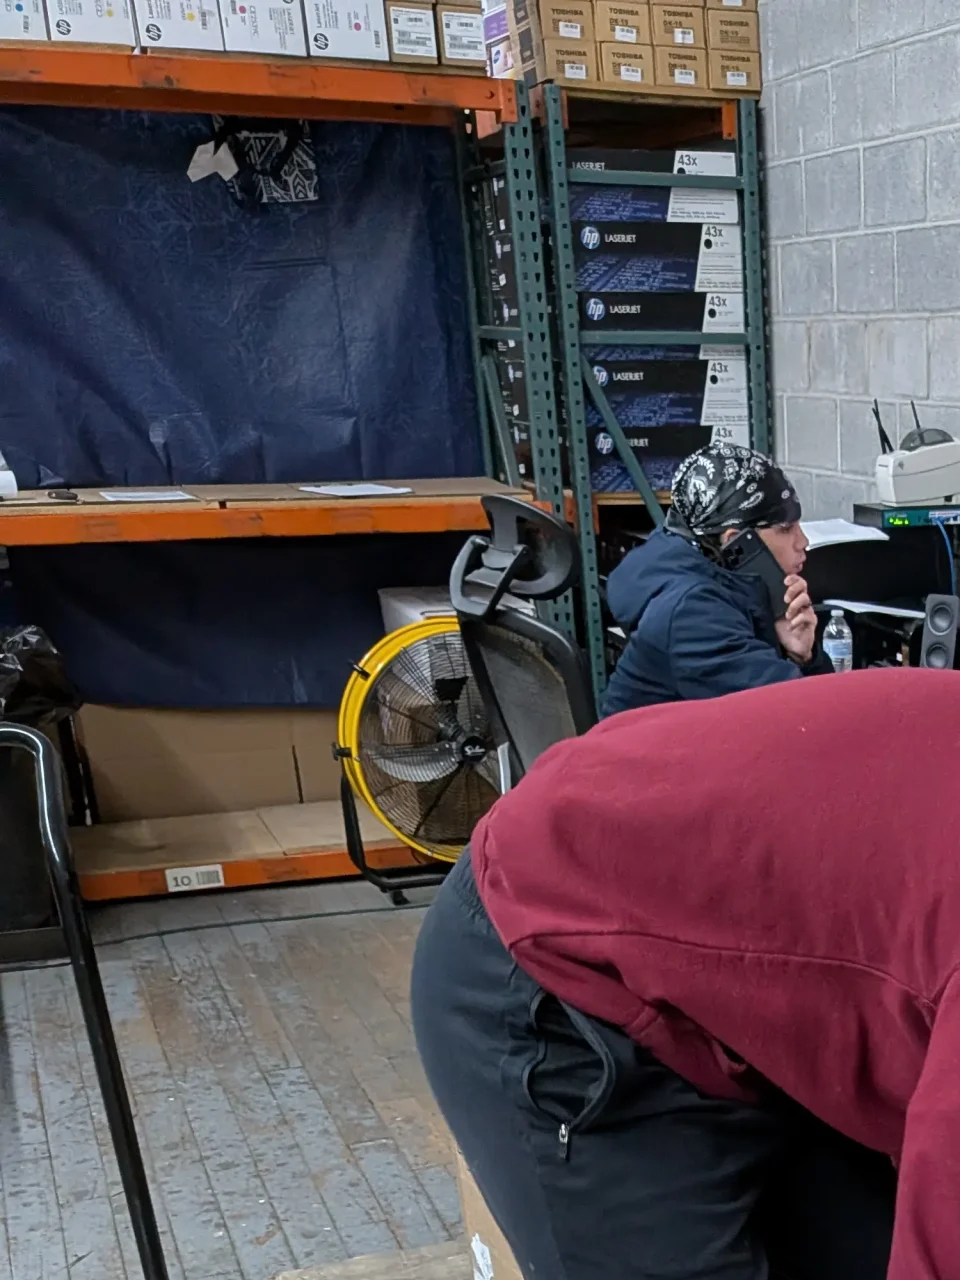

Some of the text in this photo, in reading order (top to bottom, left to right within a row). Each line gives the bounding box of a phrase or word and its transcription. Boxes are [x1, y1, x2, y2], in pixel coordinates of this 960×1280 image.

[551, 8, 583, 16] TOSHIBA
[609, 8, 639, 16] TOSHIBA
[663, 10, 693, 18] TOSHIBA
[145, 23, 162, 42] hp
[313, 33, 329, 50] hp
[555, 49, 587, 57] TOSHIBA
[612, 52, 643, 60] TOSHIBA
[668, 52, 697, 61] TOSHIBA
[720, 55, 750, 63] TOSHIBA
[572, 161, 605, 171] LASERJET
[581, 226, 600, 249] hp
[605, 234, 636, 243] LASERJET
[586, 298, 605, 320] hp
[609, 305, 641, 314] LASERJET
[612, 372, 644, 381] LASERJET
[595, 432, 613, 454] hp
[173, 875, 192, 887] 10
